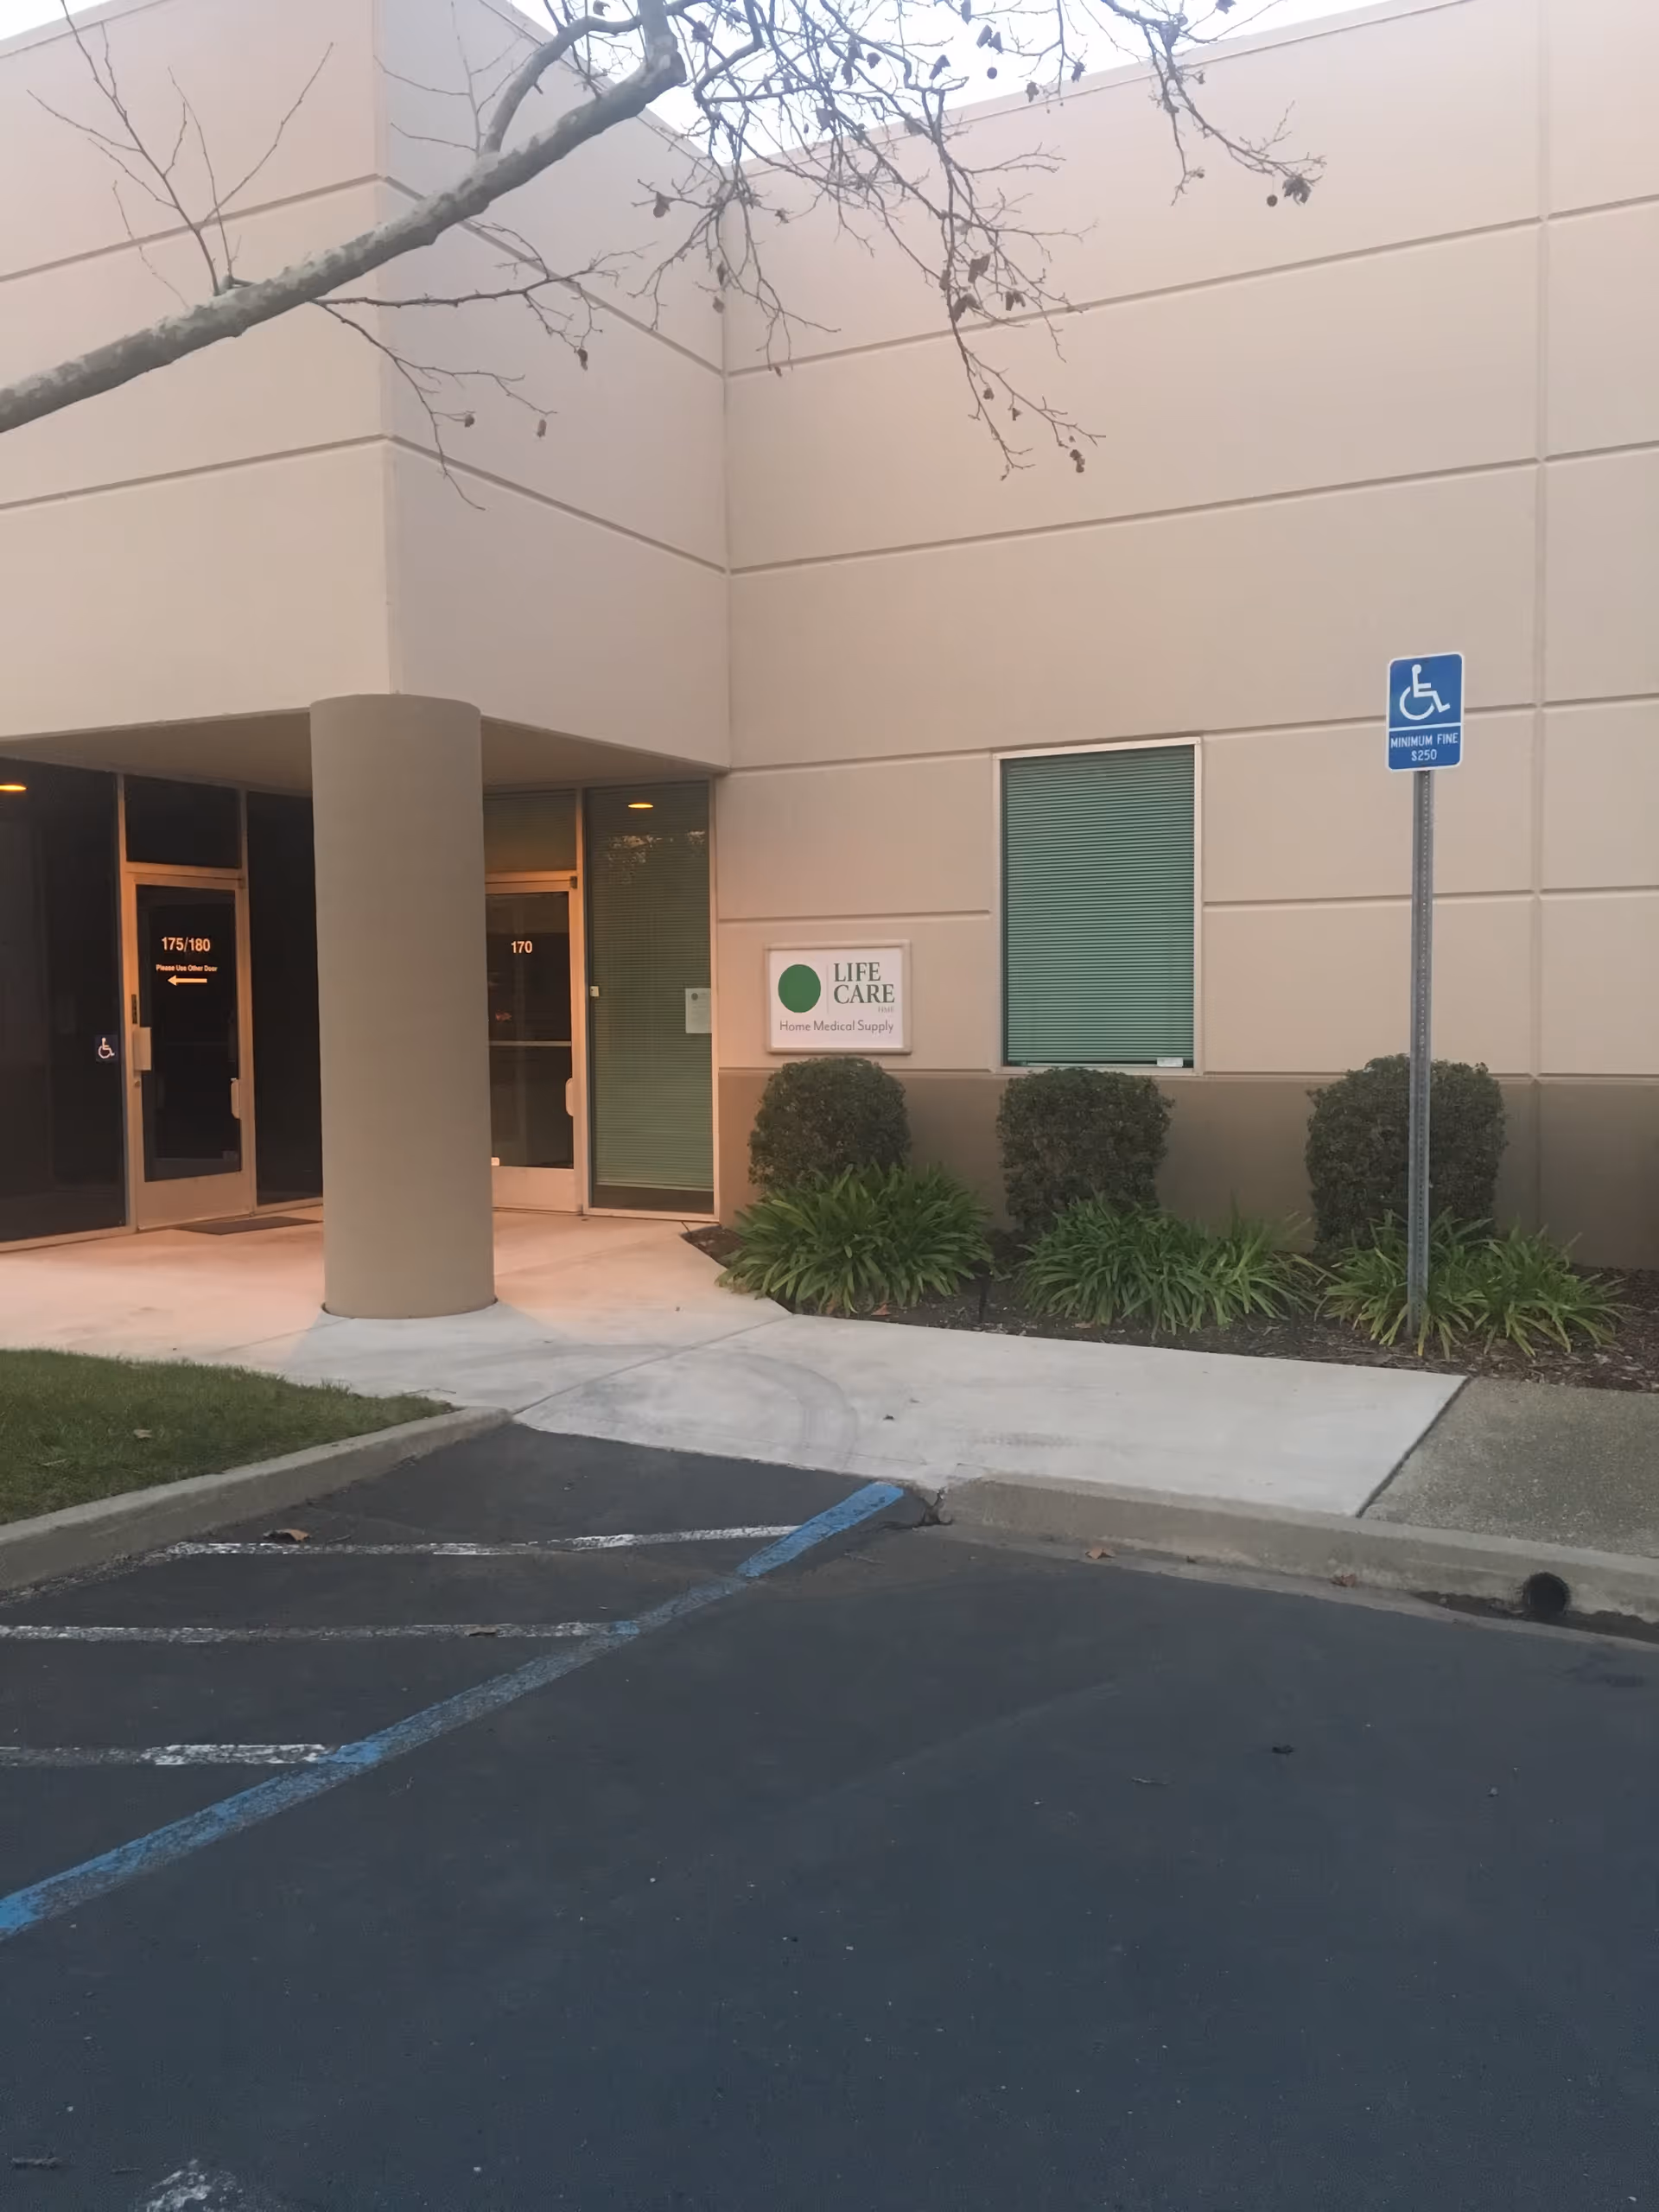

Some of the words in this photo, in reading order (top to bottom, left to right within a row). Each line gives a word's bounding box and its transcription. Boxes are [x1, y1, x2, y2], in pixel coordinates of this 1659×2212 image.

[1390, 734, 1433, 748] MINIMUM
[1437, 732, 1459, 745] FINE
[1411, 748, 1437, 761] $250
[162, 937, 211, 952] 175/180
[511, 940, 533, 954] 170
[833, 962, 881, 982] LIFE
[833, 983, 895, 1004] CARE
[779, 1020, 811, 1031] Home
[813, 1020, 855, 1031] Medical
[857, 1019, 894, 1033] Supply
